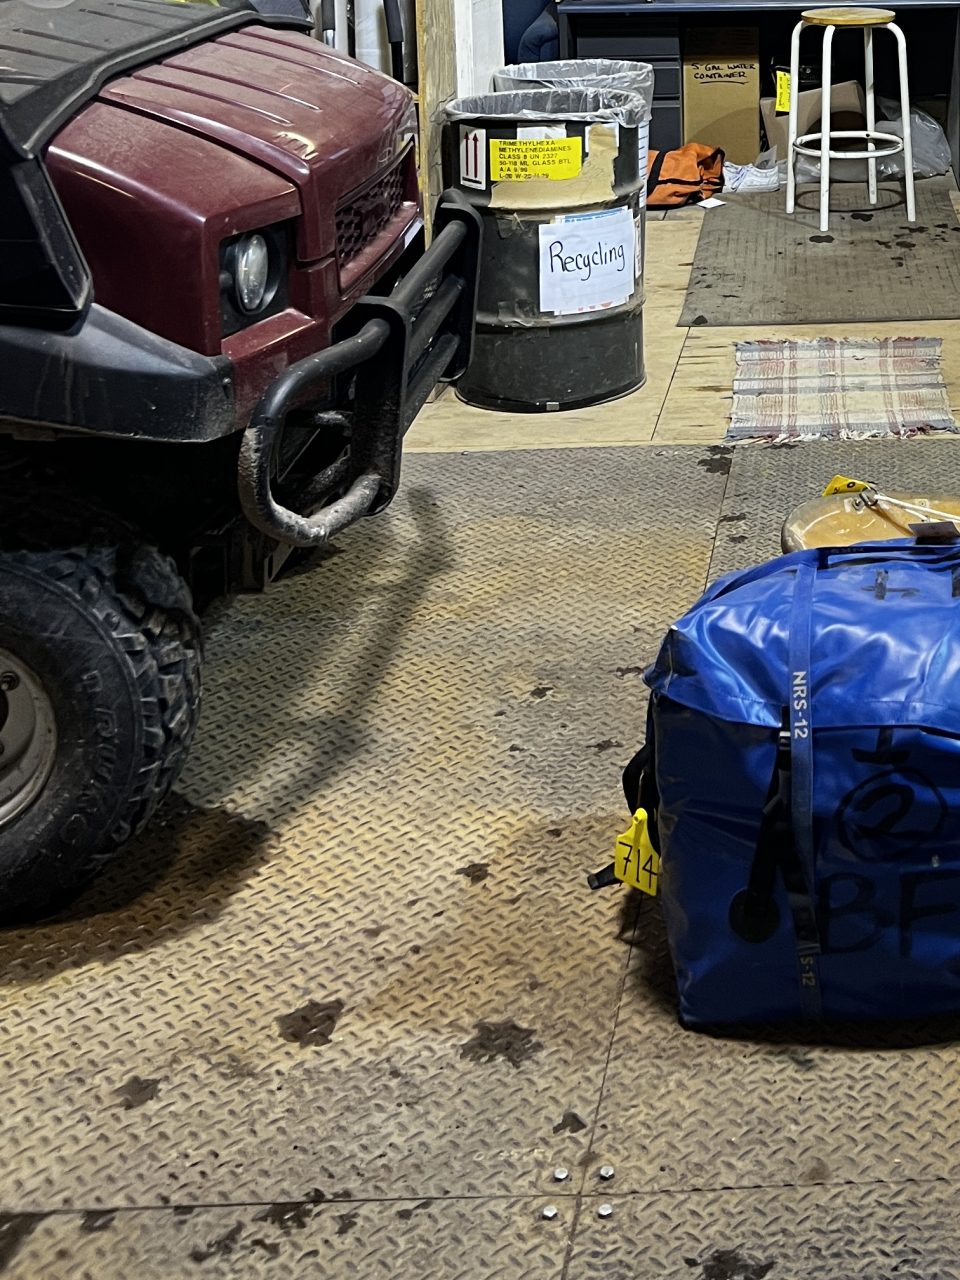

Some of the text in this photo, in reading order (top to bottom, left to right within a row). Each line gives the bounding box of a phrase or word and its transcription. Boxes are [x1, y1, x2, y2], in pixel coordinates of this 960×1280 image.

[549, 241, 626, 281] Recycling
[792, 671, 809, 739] NRS-12
[618, 841, 659, 889] 714
